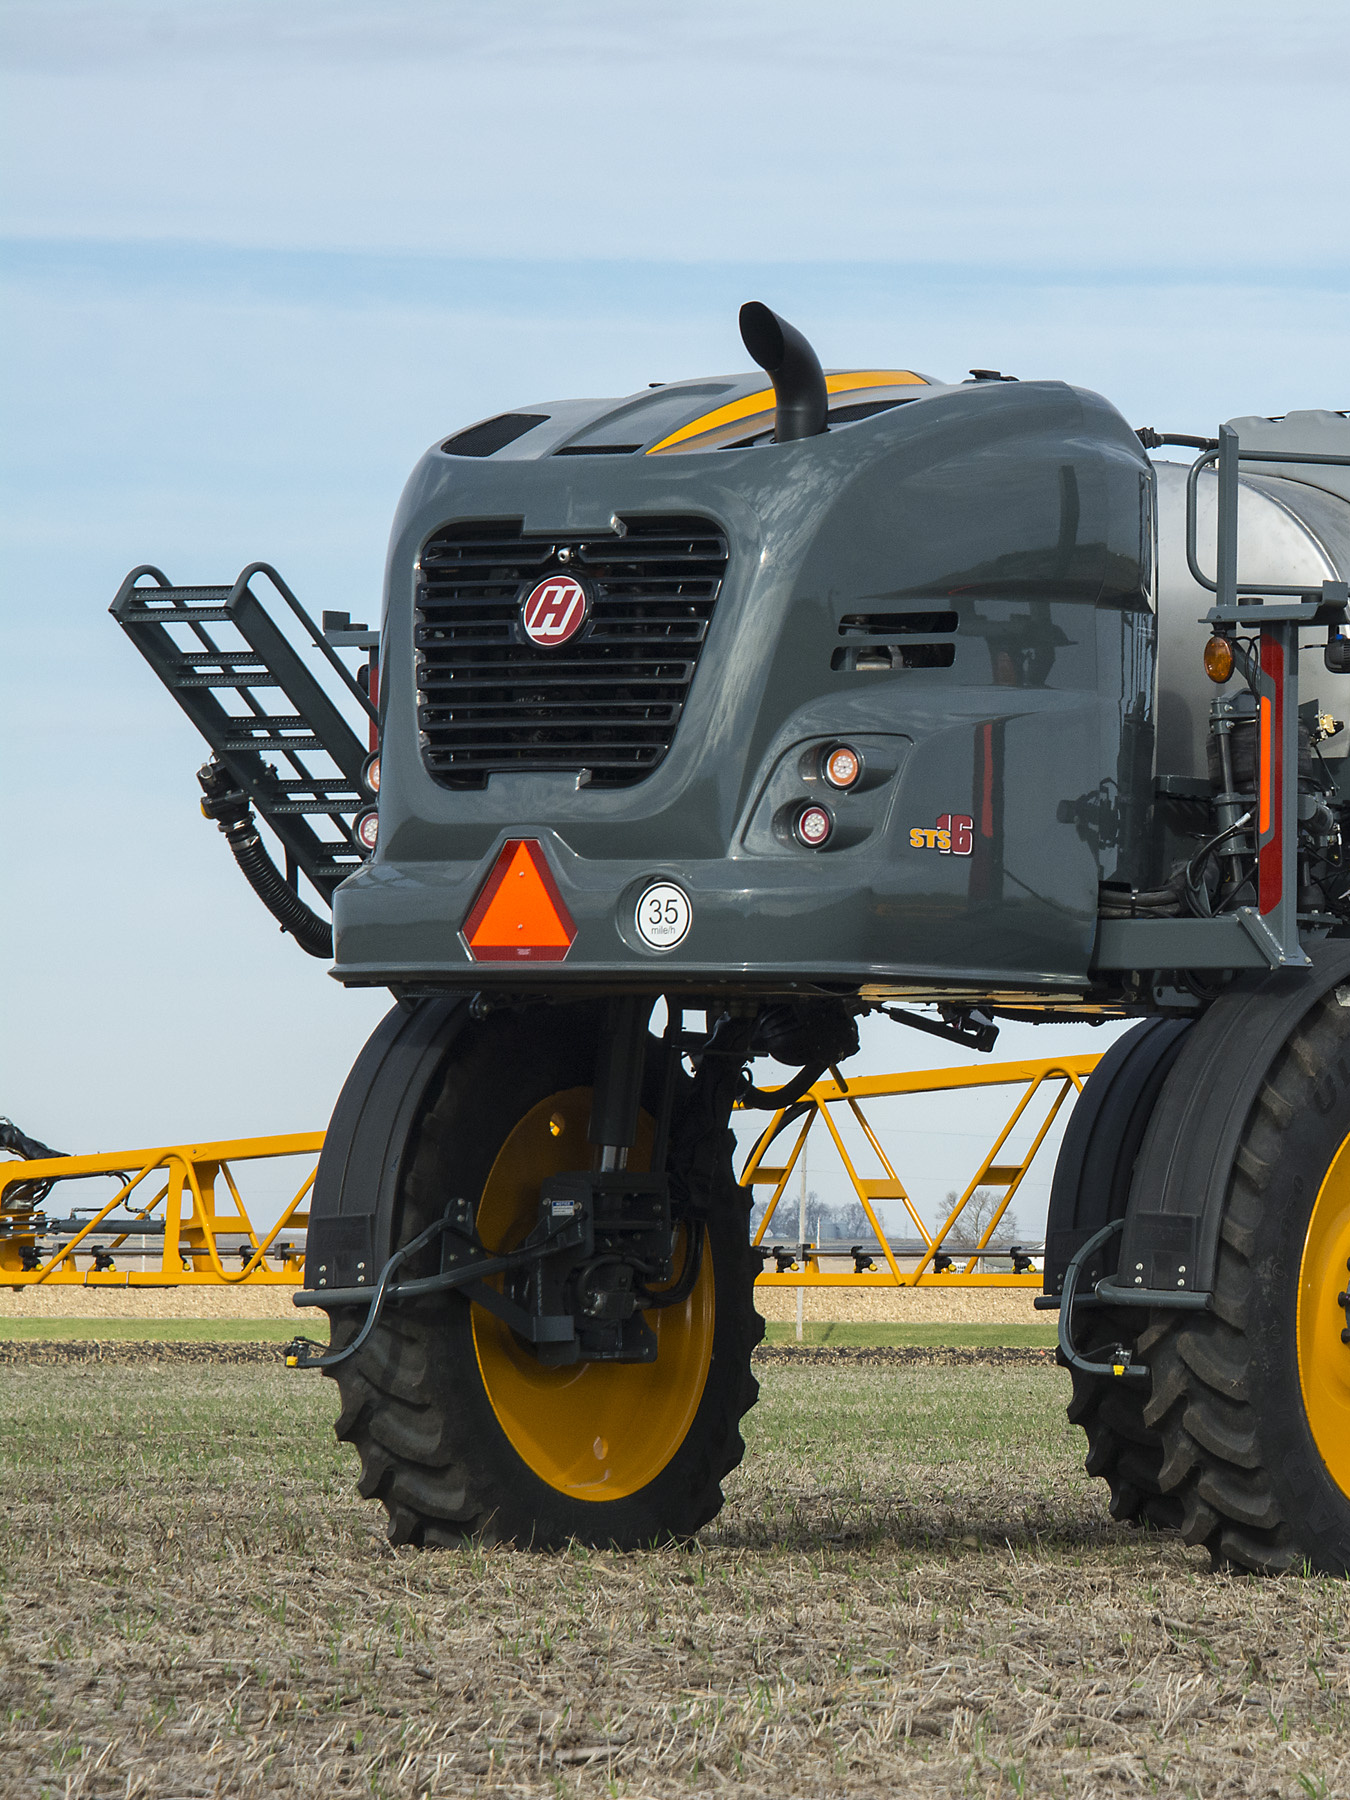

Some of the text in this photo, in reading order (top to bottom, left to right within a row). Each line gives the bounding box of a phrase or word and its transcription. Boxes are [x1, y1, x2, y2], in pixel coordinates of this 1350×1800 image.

[528, 586, 582, 636] H
[649, 899, 678, 924] 35
[651, 926, 676, 935] mile/h
